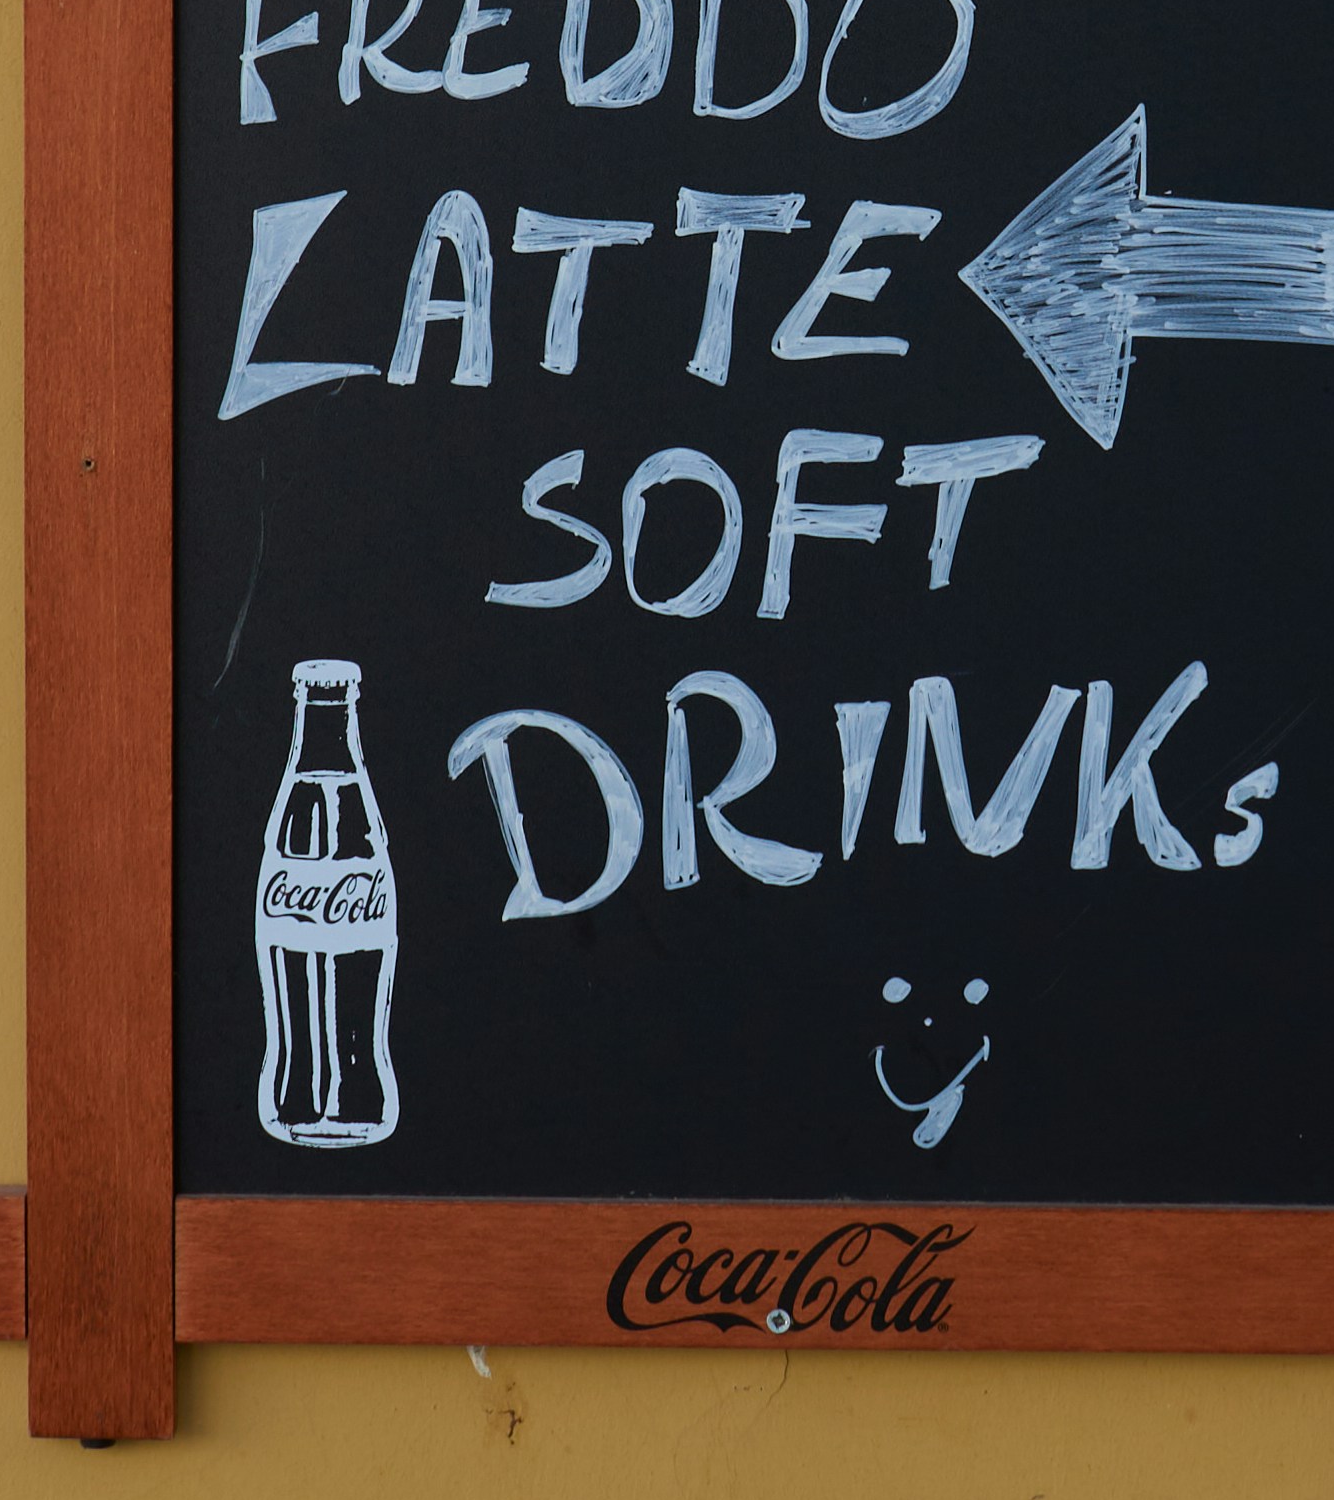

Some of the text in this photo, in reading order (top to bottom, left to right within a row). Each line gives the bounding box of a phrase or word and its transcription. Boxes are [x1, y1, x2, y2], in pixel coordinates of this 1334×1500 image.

[218, 187, 942, 420] LATTE
[485, 429, 1045, 619] SOFT
[263, 868, 387, 924] Coca-Cola
[606, 1221, 974, 1333] Coca-Cola
